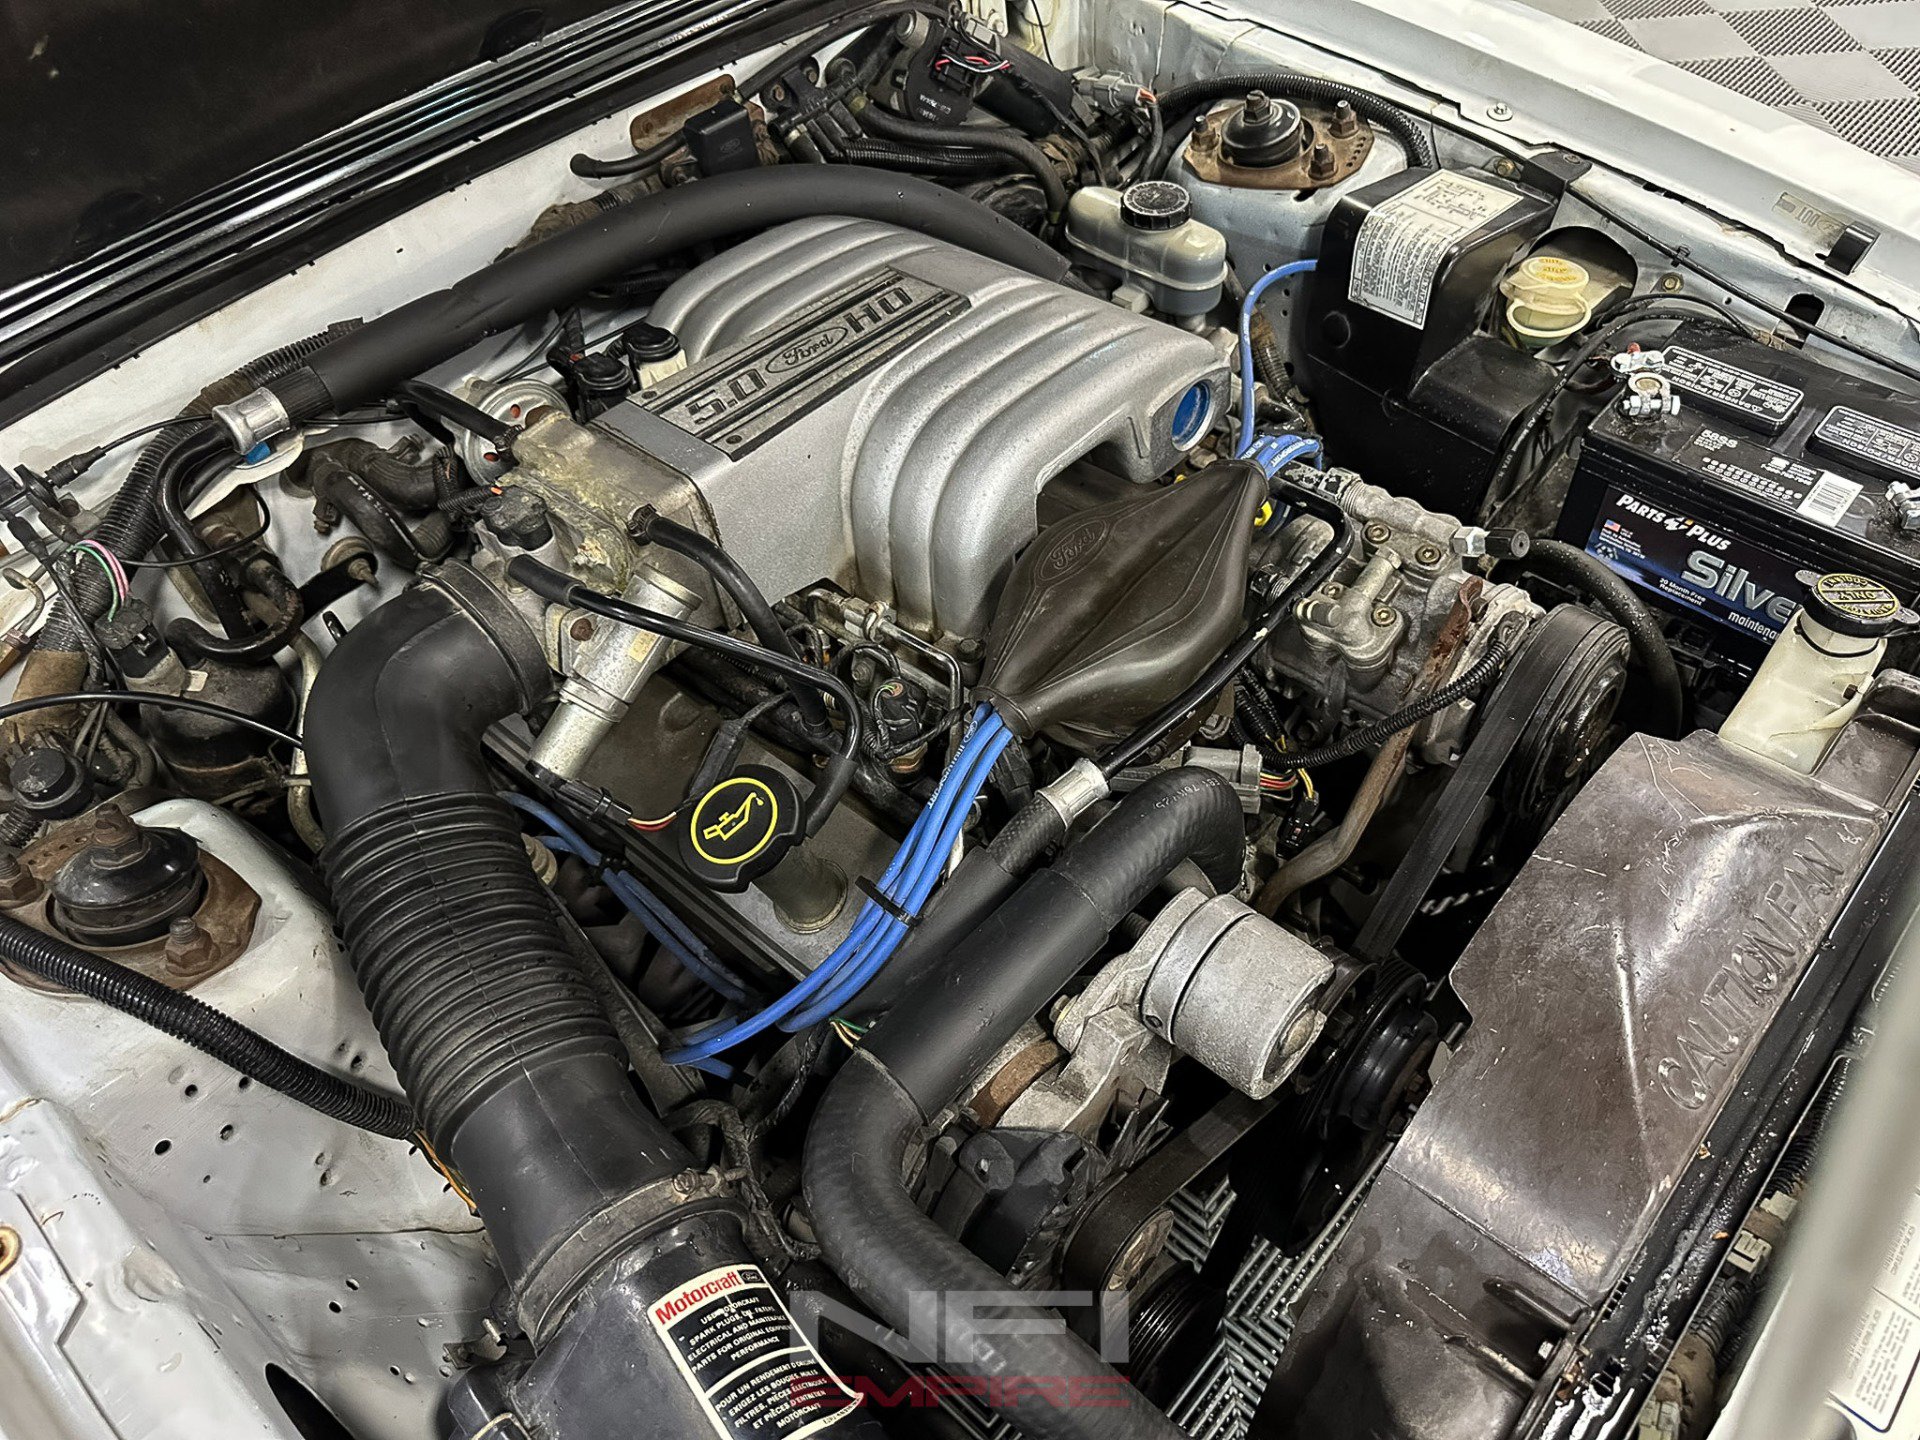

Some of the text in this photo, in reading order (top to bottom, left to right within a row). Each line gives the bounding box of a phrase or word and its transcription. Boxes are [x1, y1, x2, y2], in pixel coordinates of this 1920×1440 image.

[685, 287, 913, 425] 5.0 Ford HO
[1616, 494, 1731, 550] PARTS PLUS
[1051, 528, 1098, 570] Ford
[1659, 584, 1703, 606] Replacement
[1668, 581, 1690, 594] Month
[1690, 591, 1706, 602] Free
[1681, 550, 1798, 624] Silve
[1658, 836, 1844, 1110] CAUTION FAN
[655, 1271, 742, 1325] Motorcraft
[687, 1330, 732, 1362] ELECTRICAL
[732, 1323, 748, 1334] AND
[689, 1326, 716, 1346] SPARK
[692, 1353, 717, 1373] PARTS
[717, 1343, 733, 1355] FOR
[733, 1328, 766, 1346] ORIGINAL
[730, 1336, 779, 1361] PERFORMANCE
[715, 1391, 738, 1412] POUR
[737, 1383, 751, 1395] UN
[750, 1362, 791, 1387] RENDEMENT
[728, 1394, 757, 1417] EXIGEZ
[756, 1385, 771, 1397] LES
[734, 1403, 768, 1428] FILTRES,
[752, 1418, 764, 1430] ET
